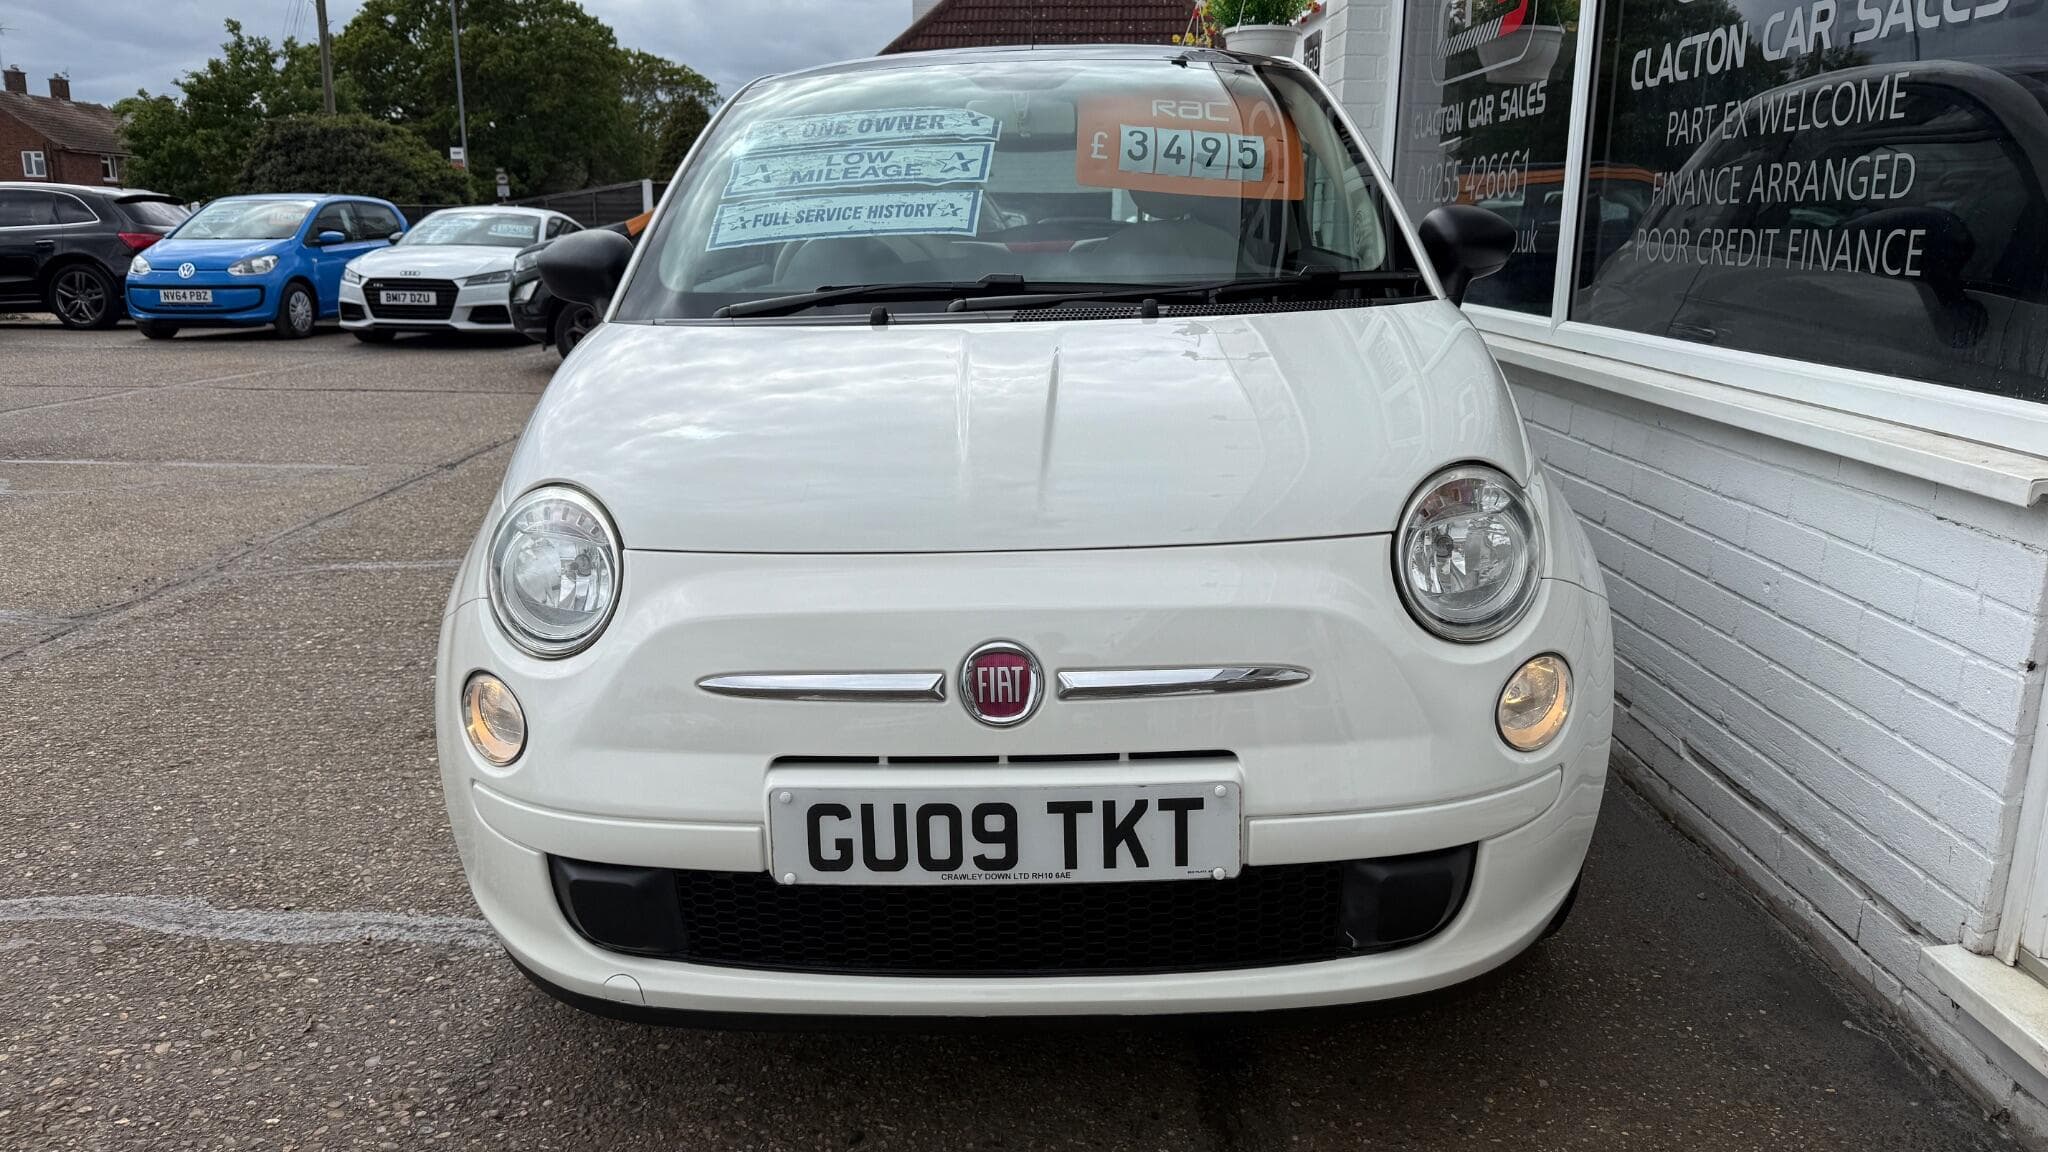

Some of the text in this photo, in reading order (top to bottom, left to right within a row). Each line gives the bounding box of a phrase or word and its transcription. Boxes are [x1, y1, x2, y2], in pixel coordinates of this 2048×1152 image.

[1631, 21, 1749, 91] CLACTON
[1762, 0, 1837, 62] CAR
[802, 113, 946, 137] ONE OWNER
[1414, 79, 1548, 139] CLACTON CAR SALES
[1666, 71, 1910, 147] PART EX WELCOME
[789, 163, 923, 185] MILEAGE
[826, 150, 893, 167] LOW
[1417, 147, 1531, 205] 01255 426661
[1651, 152, 1917, 208] FINANCE ARRANGED
[752, 203, 937, 230] FULL SERVICE HISTORY
[1635, 227, 1927, 277] POOR CREDIT FINANCE
[163, 291, 209, 301] NV64 PBZ
[410, 293, 430, 303] DZU
[977, 665, 1024, 703] FIAT
[806, 797, 1204, 872] GU09 TKT
[941, 873, 983, 881] CRAWLEY
[1013, 872, 1030, 880] LTD
[1055, 871, 1072, 879] 6AE
